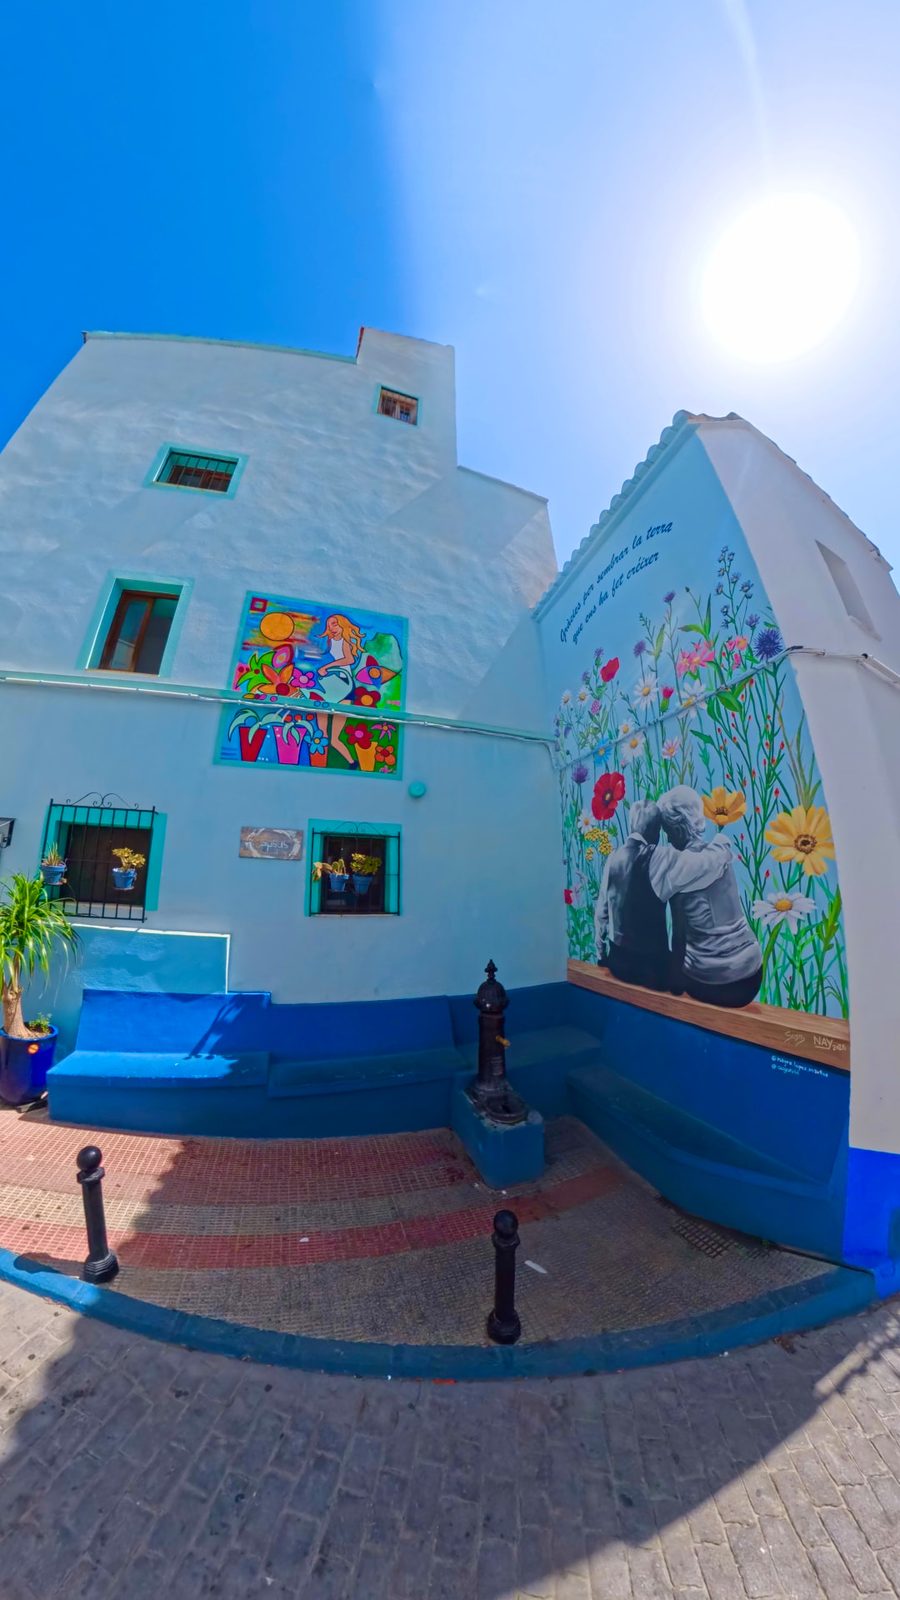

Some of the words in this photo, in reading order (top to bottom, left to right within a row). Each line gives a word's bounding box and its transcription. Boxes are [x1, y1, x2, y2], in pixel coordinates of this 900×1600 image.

[573, 623, 583, 646] que
[585, 605, 597, 624] ens
[598, 591, 609, 606] ha
[611, 573, 624, 598] fet
[626, 552, 659, 580] créixer
[583, 584, 594, 605] per
[596, 546, 629, 584] sembrar
[632, 535, 642, 550] la
[646, 522, 673, 540] terra
[813, 1034, 833, 1050] NAY
